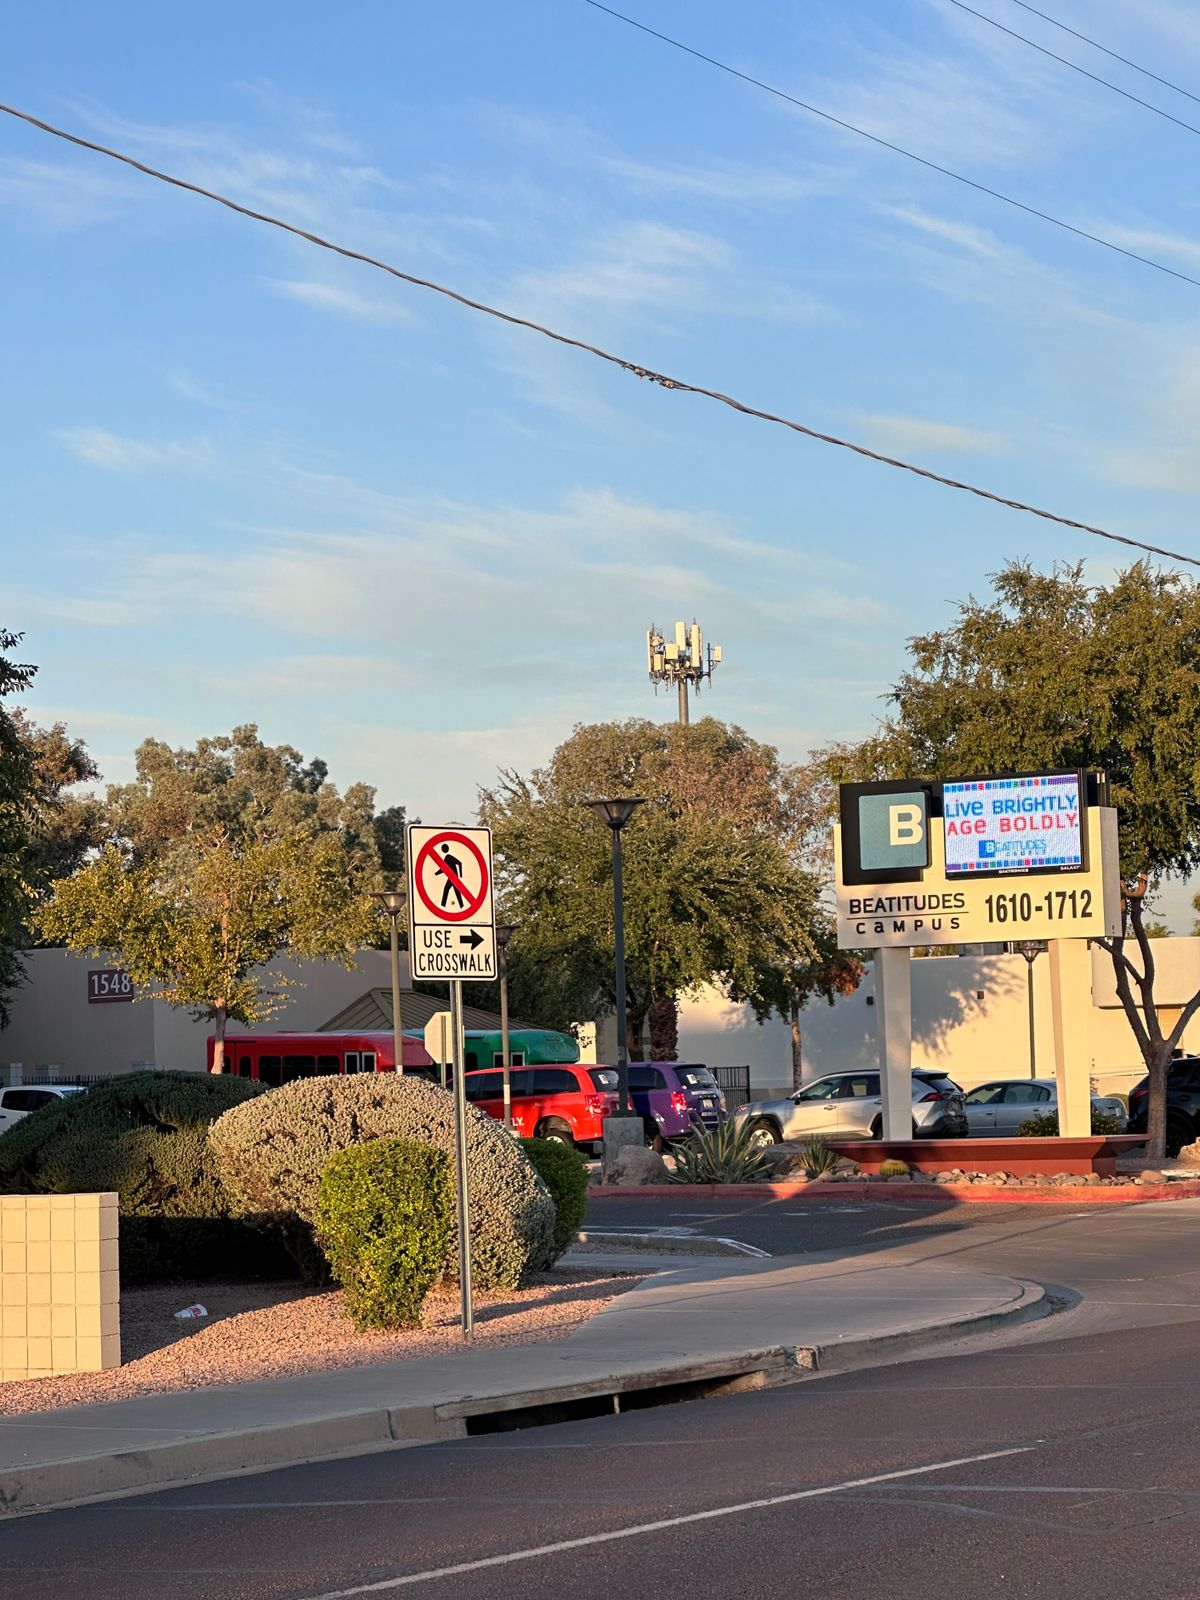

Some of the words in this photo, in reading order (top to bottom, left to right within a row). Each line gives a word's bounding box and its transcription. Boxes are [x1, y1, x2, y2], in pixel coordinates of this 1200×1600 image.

[945, 799, 984, 818] Live
[889, 804, 924, 846] B
[999, 812, 1079, 833] BOLDLY.
[849, 893, 966, 914] BEATITUDES
[985, 889, 1093, 923] 1610-1712
[423, 930, 453, 948] USE
[419, 953, 492, 972] CROSSWALK
[91, 973, 131, 994] 1548
